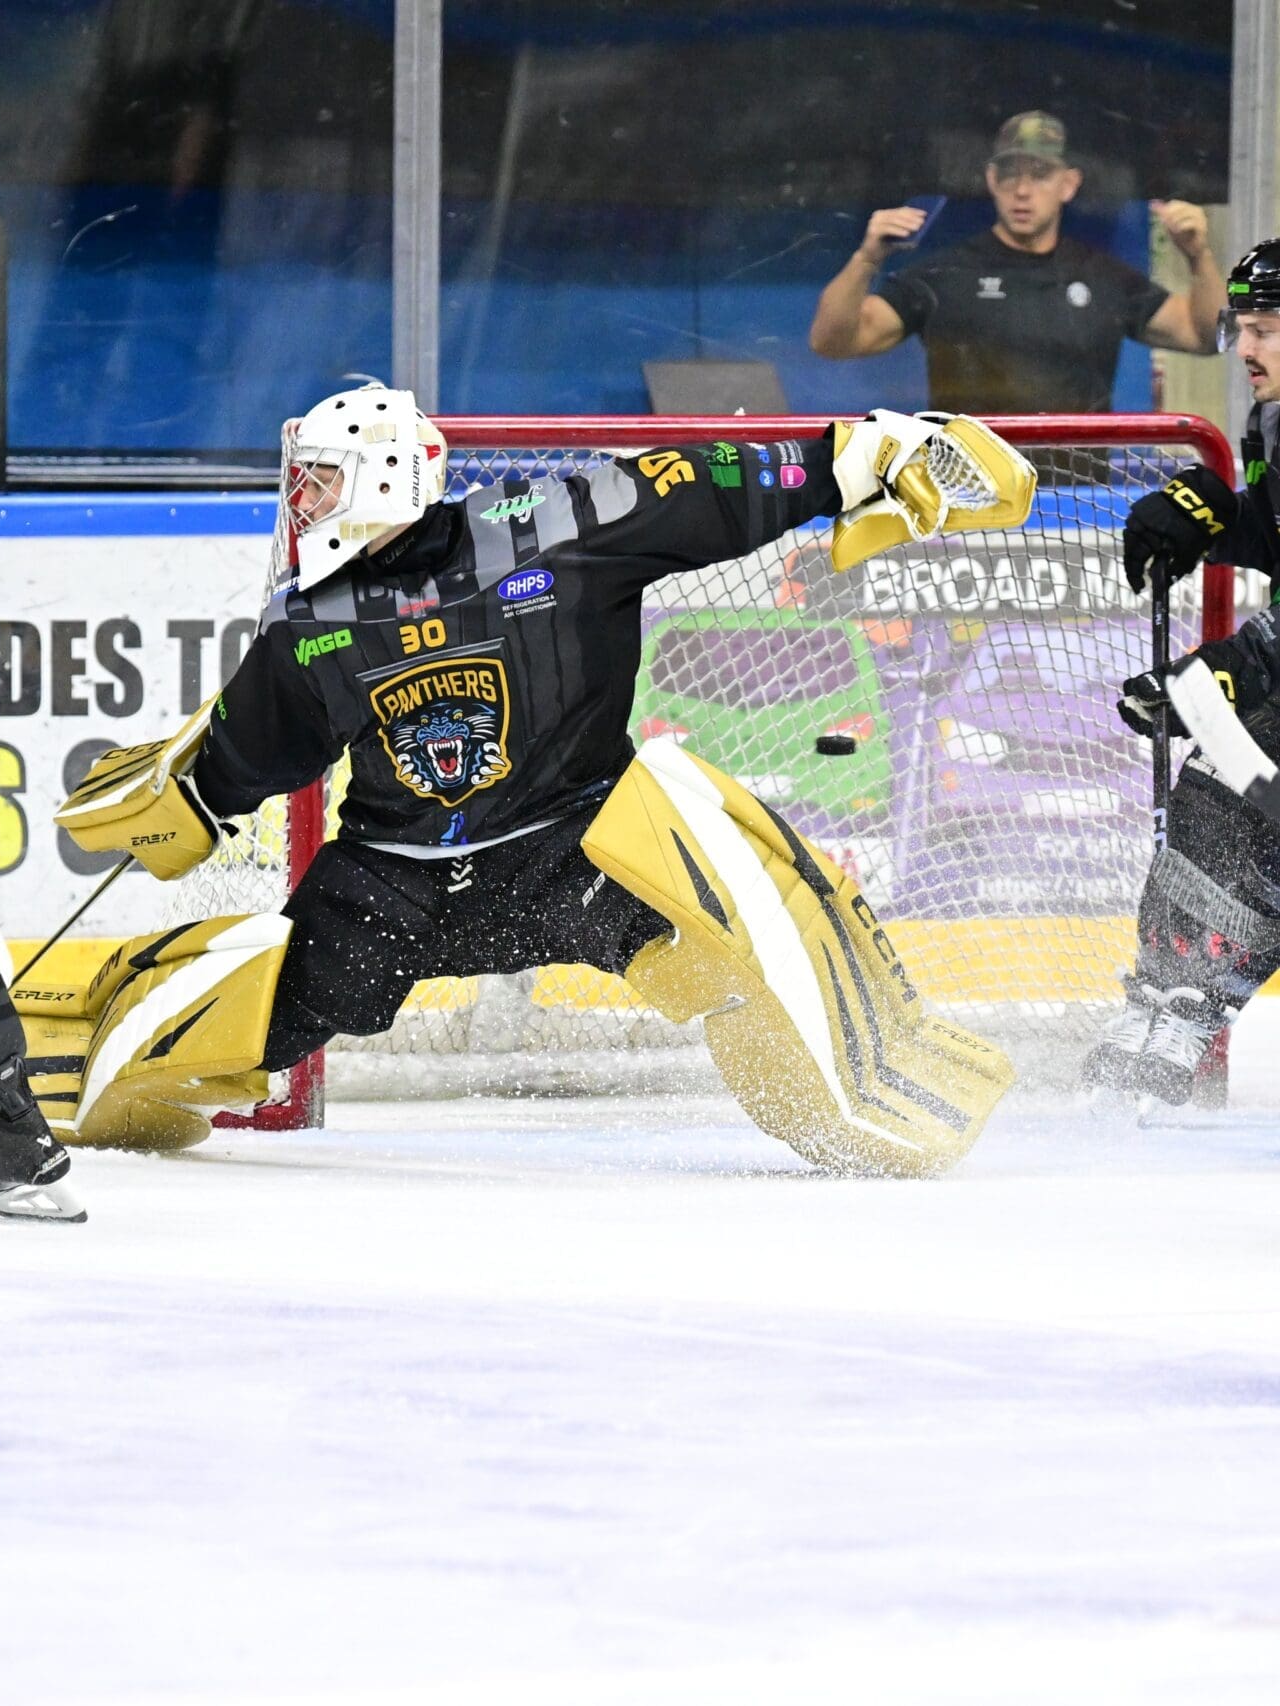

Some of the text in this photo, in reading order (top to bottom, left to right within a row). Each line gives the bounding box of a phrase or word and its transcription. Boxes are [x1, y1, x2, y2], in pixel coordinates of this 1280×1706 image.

[877, 441, 894, 472] CCM
[412, 454, 421, 508] BAUER
[1163, 479, 1225, 535] CCM
[502, 595, 549, 612] REFRIGERATION
[506, 573, 546, 597] RHPS
[862, 556, 1069, 614] BROAD
[515, 601, 558, 616] CONDITIONING
[294, 628, 353, 667] VAGO
[399, 618, 447, 655] 30
[383, 670, 498, 725] PANTHERS
[852, 894, 918, 1005] CCM
